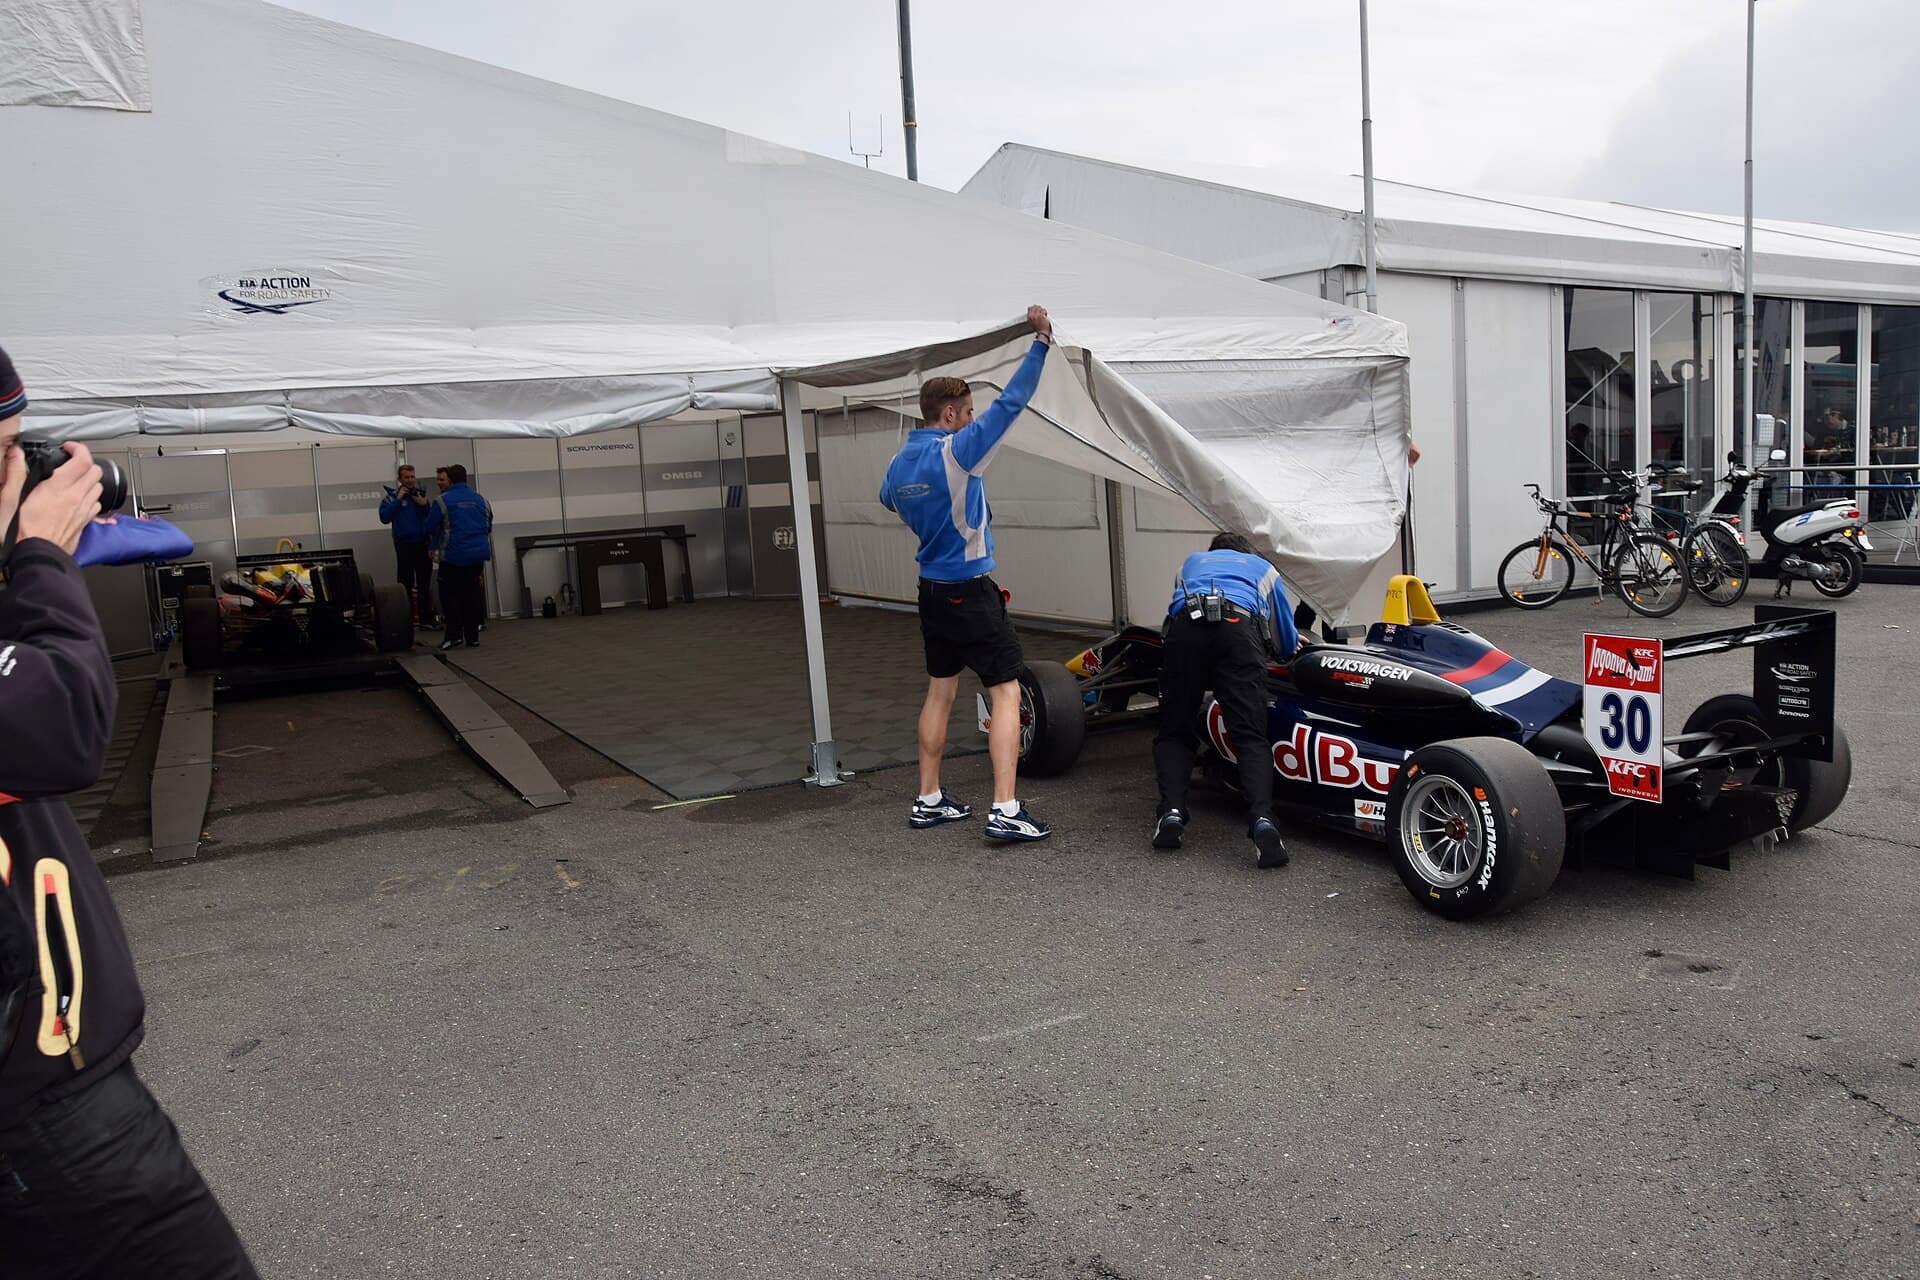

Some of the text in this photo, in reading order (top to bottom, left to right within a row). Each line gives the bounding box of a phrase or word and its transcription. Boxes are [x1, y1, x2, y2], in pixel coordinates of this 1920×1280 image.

[239, 277, 310, 289] FIA ACTION
[257, 290, 288, 300] ROAD
[290, 289, 331, 299] SAFETY
[566, 443, 635, 453] SCRUTINEERING
[661, 470, 703, 481] DMSB
[1633, 648, 1656, 658] KFC
[1319, 655, 1414, 682] VOLKSWAGEN
[1787, 663, 1809, 671] ACTION
[1600, 691, 1653, 755] 30
[1608, 759, 1647, 778] KFC
[1618, 787, 1659, 799] INDONESIA
